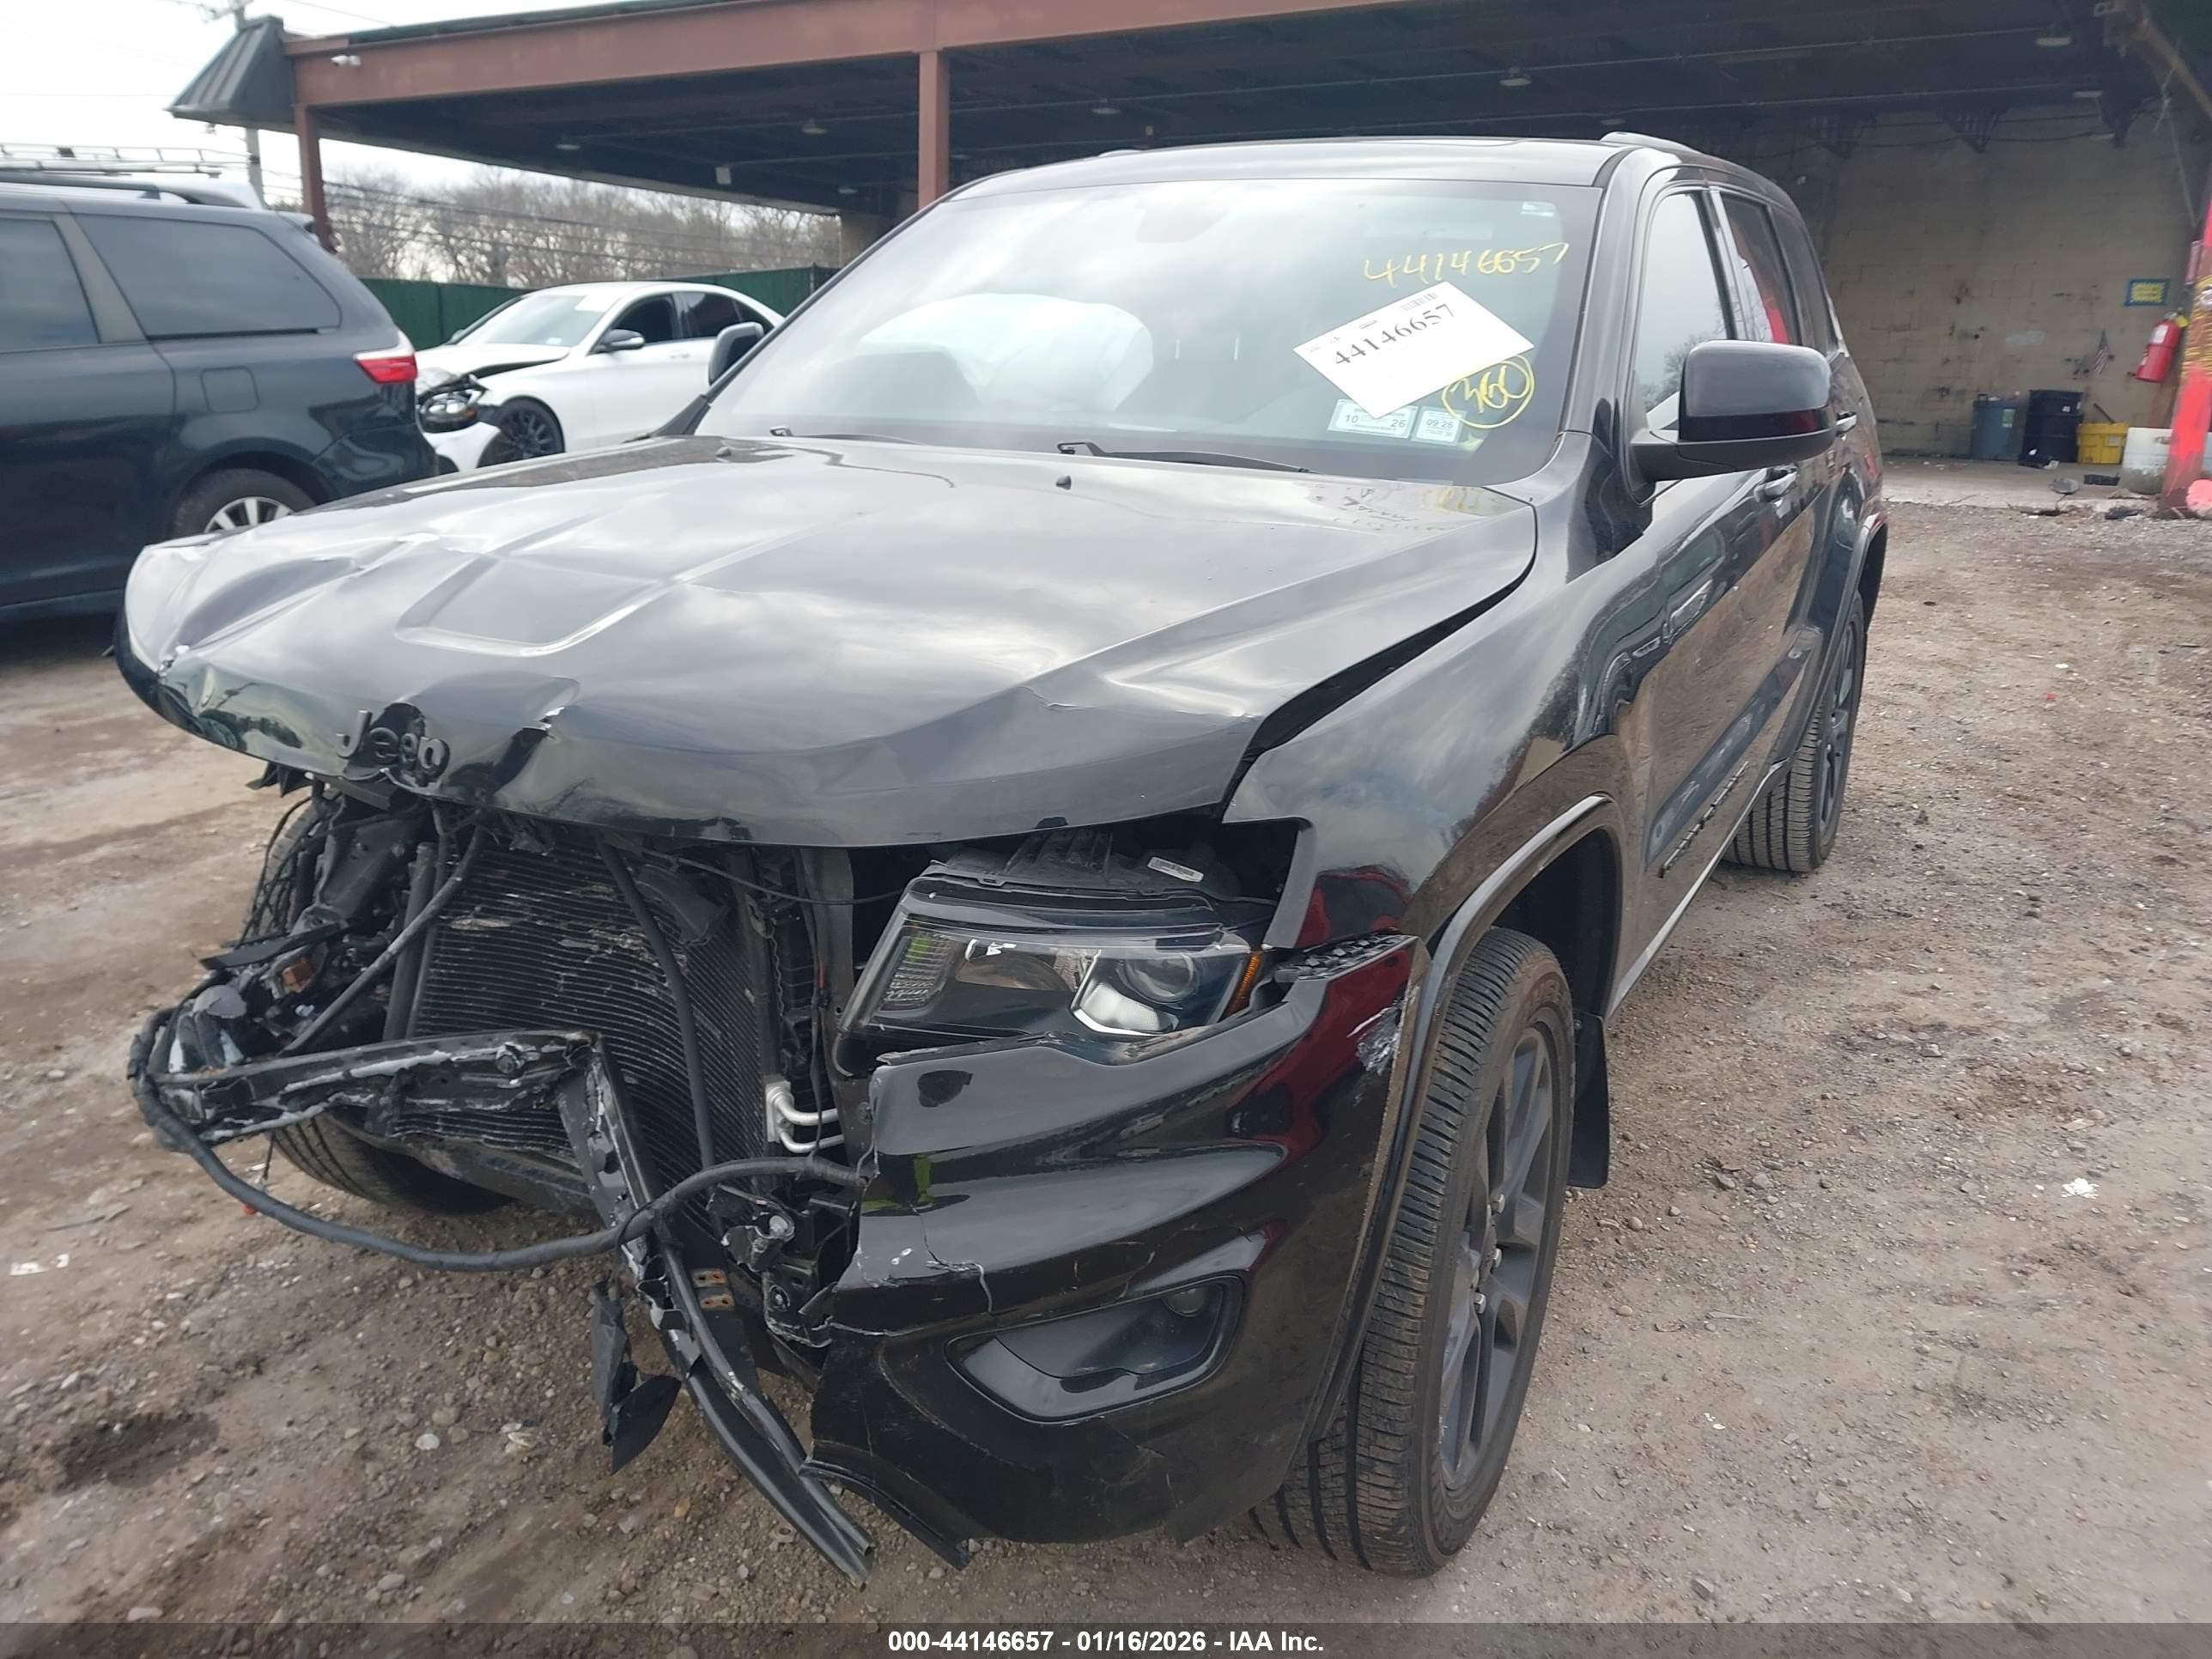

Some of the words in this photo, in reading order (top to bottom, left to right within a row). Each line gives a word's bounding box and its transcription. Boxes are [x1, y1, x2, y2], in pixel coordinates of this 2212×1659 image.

[1364, 241, 1570, 288] 44146657
[1335, 303, 1454, 364] 44146657
[1390, 418, 1407, 428] 26
[337, 709, 451, 782] Jeep
